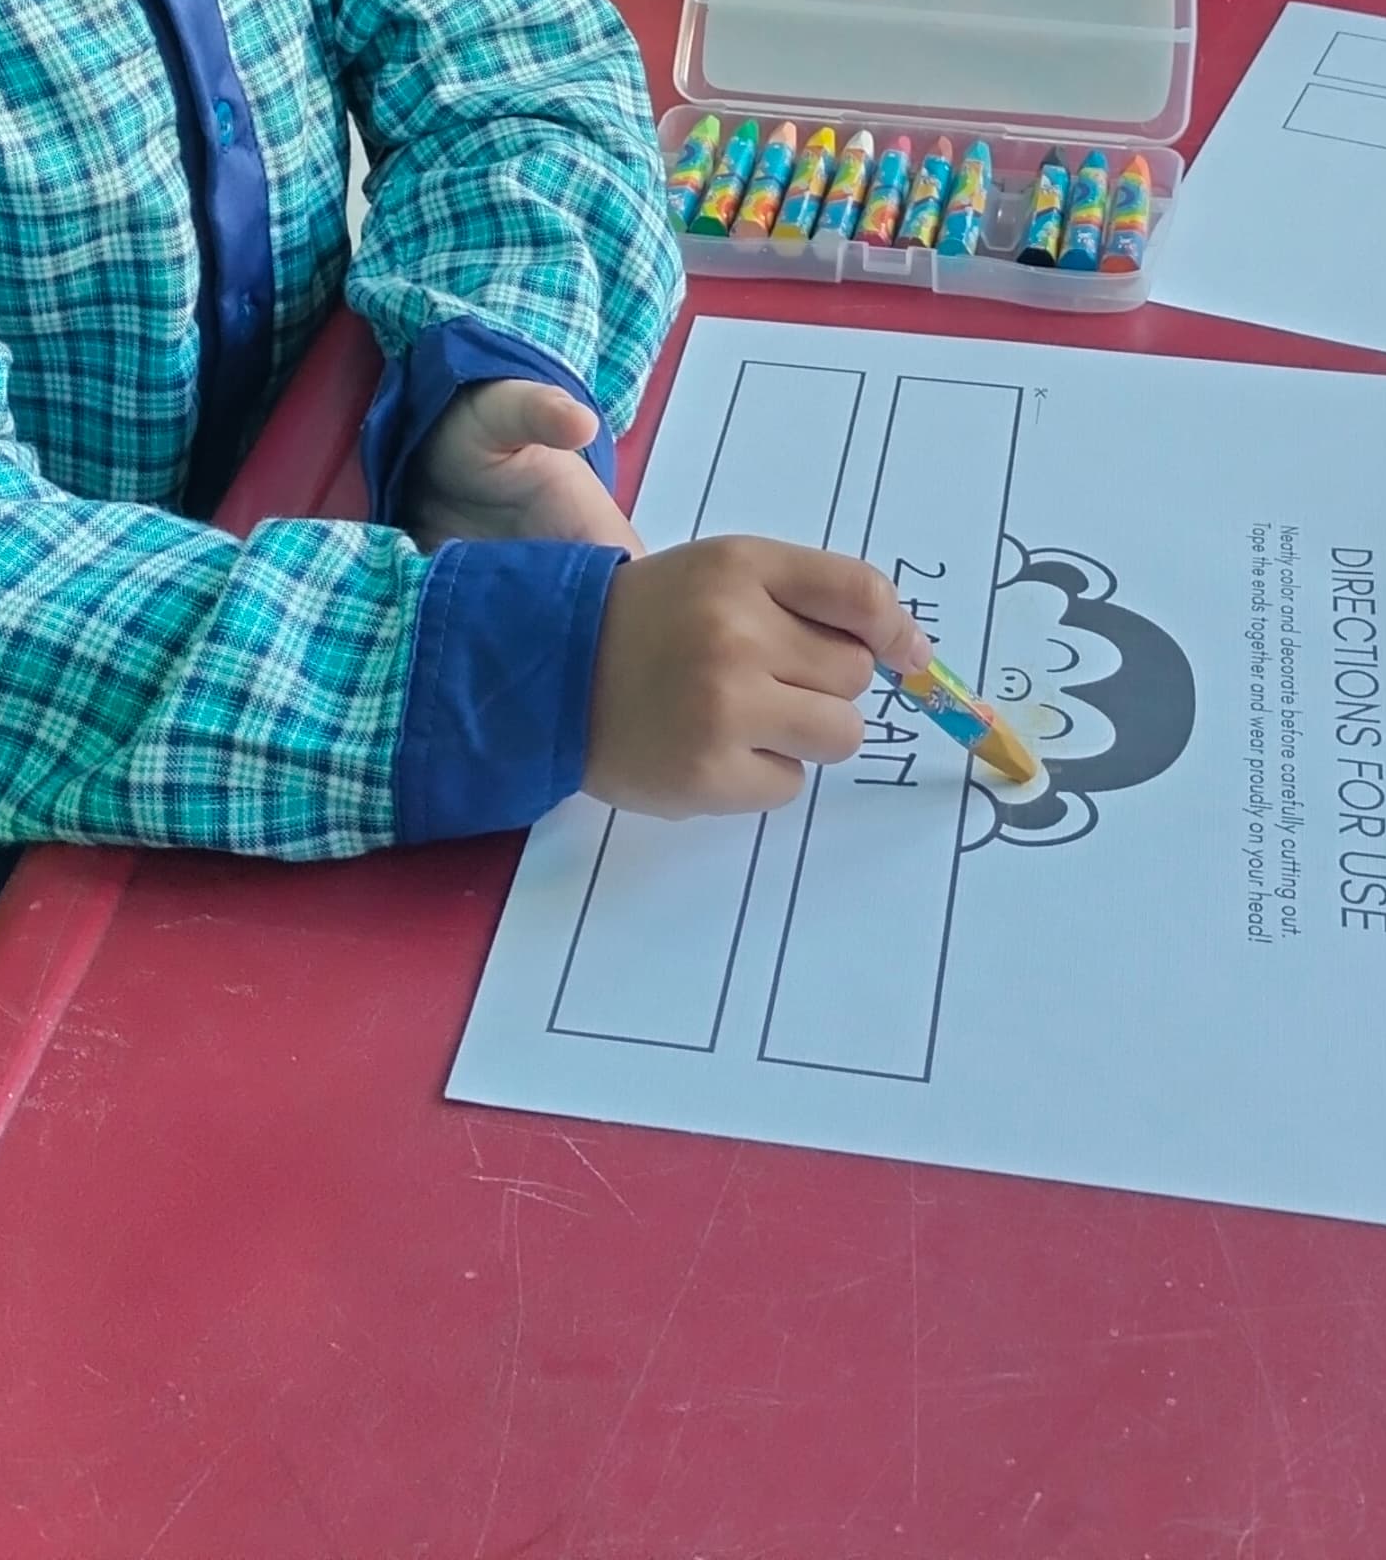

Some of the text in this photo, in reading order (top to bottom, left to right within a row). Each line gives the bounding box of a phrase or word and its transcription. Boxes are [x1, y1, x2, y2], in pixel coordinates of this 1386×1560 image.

[1241, 523, 1273, 943] Tape the ends together and wear proudly on your head!
[1274, 526, 1305, 938] Neatly color and decorate before carefully cutting out.
[1331, 547, 1382, 747] DIRECTIONS
[1337, 758, 1386, 837] FOR
